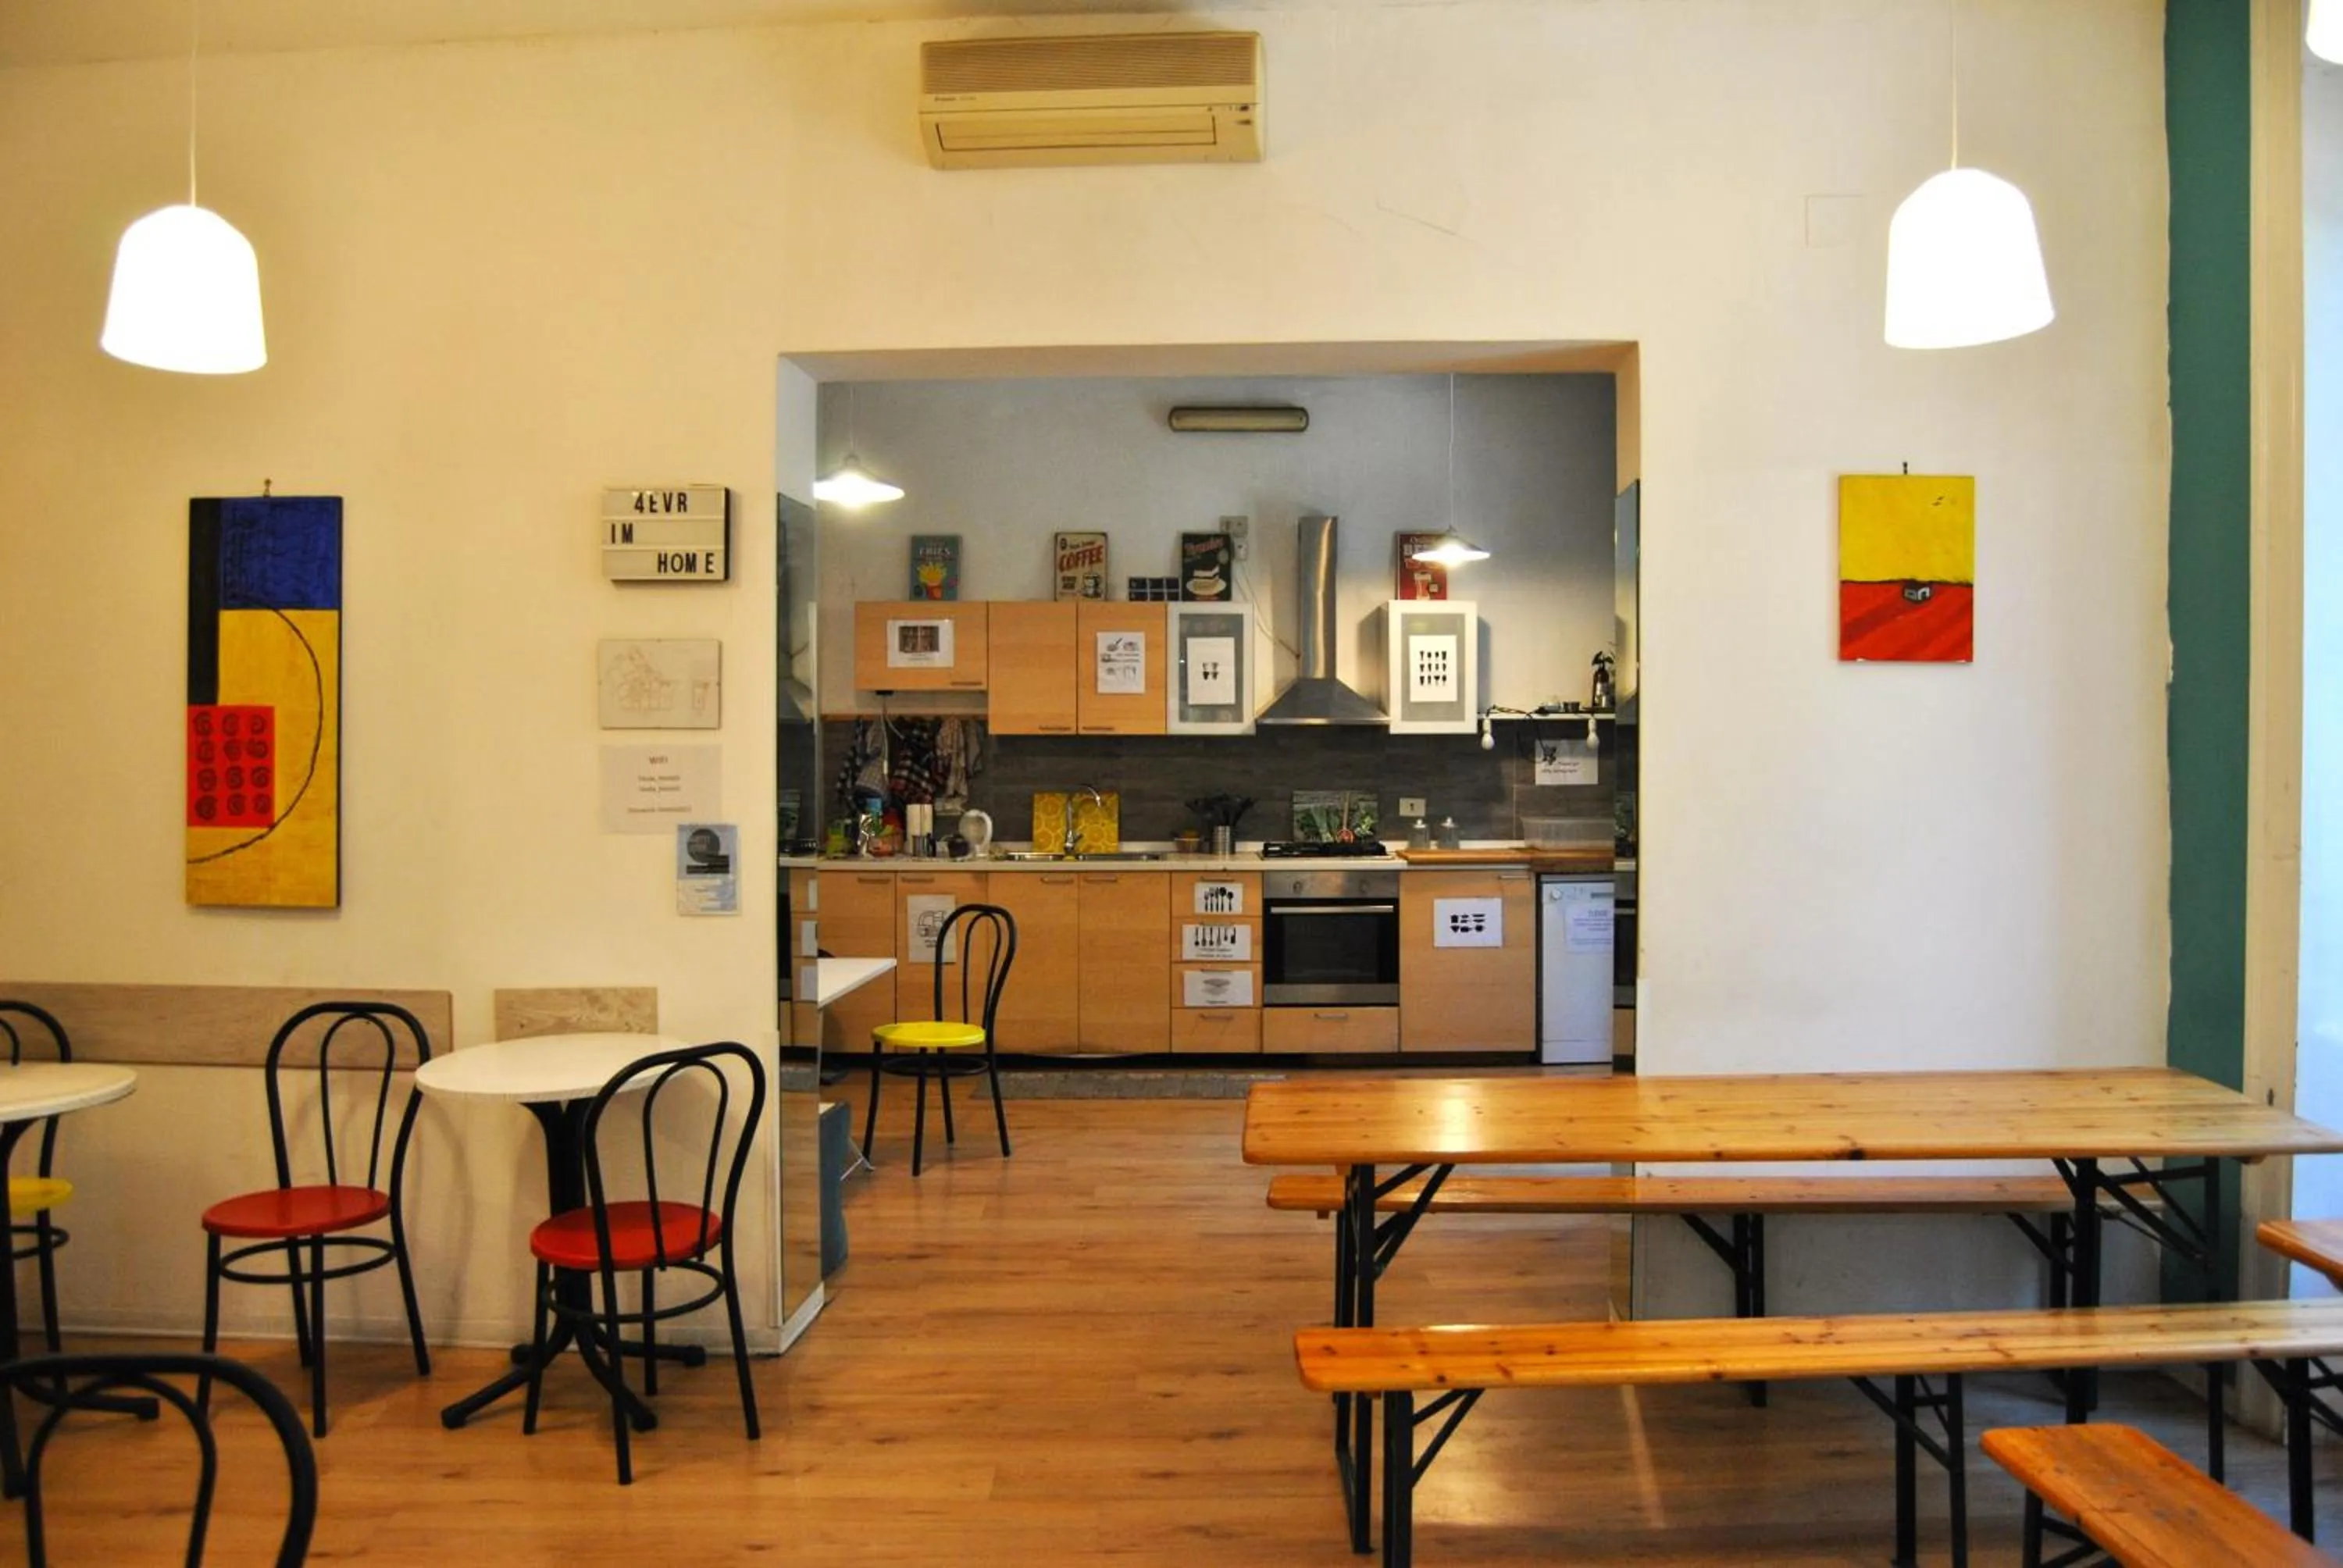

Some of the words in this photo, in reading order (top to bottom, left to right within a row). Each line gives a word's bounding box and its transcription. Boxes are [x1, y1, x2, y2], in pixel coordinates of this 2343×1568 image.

[634, 492, 687, 513] 4EVR
[612, 523, 633, 543] IM
[658, 553, 715, 573] HOME
[1059, 545, 1104, 572] COFFEE
